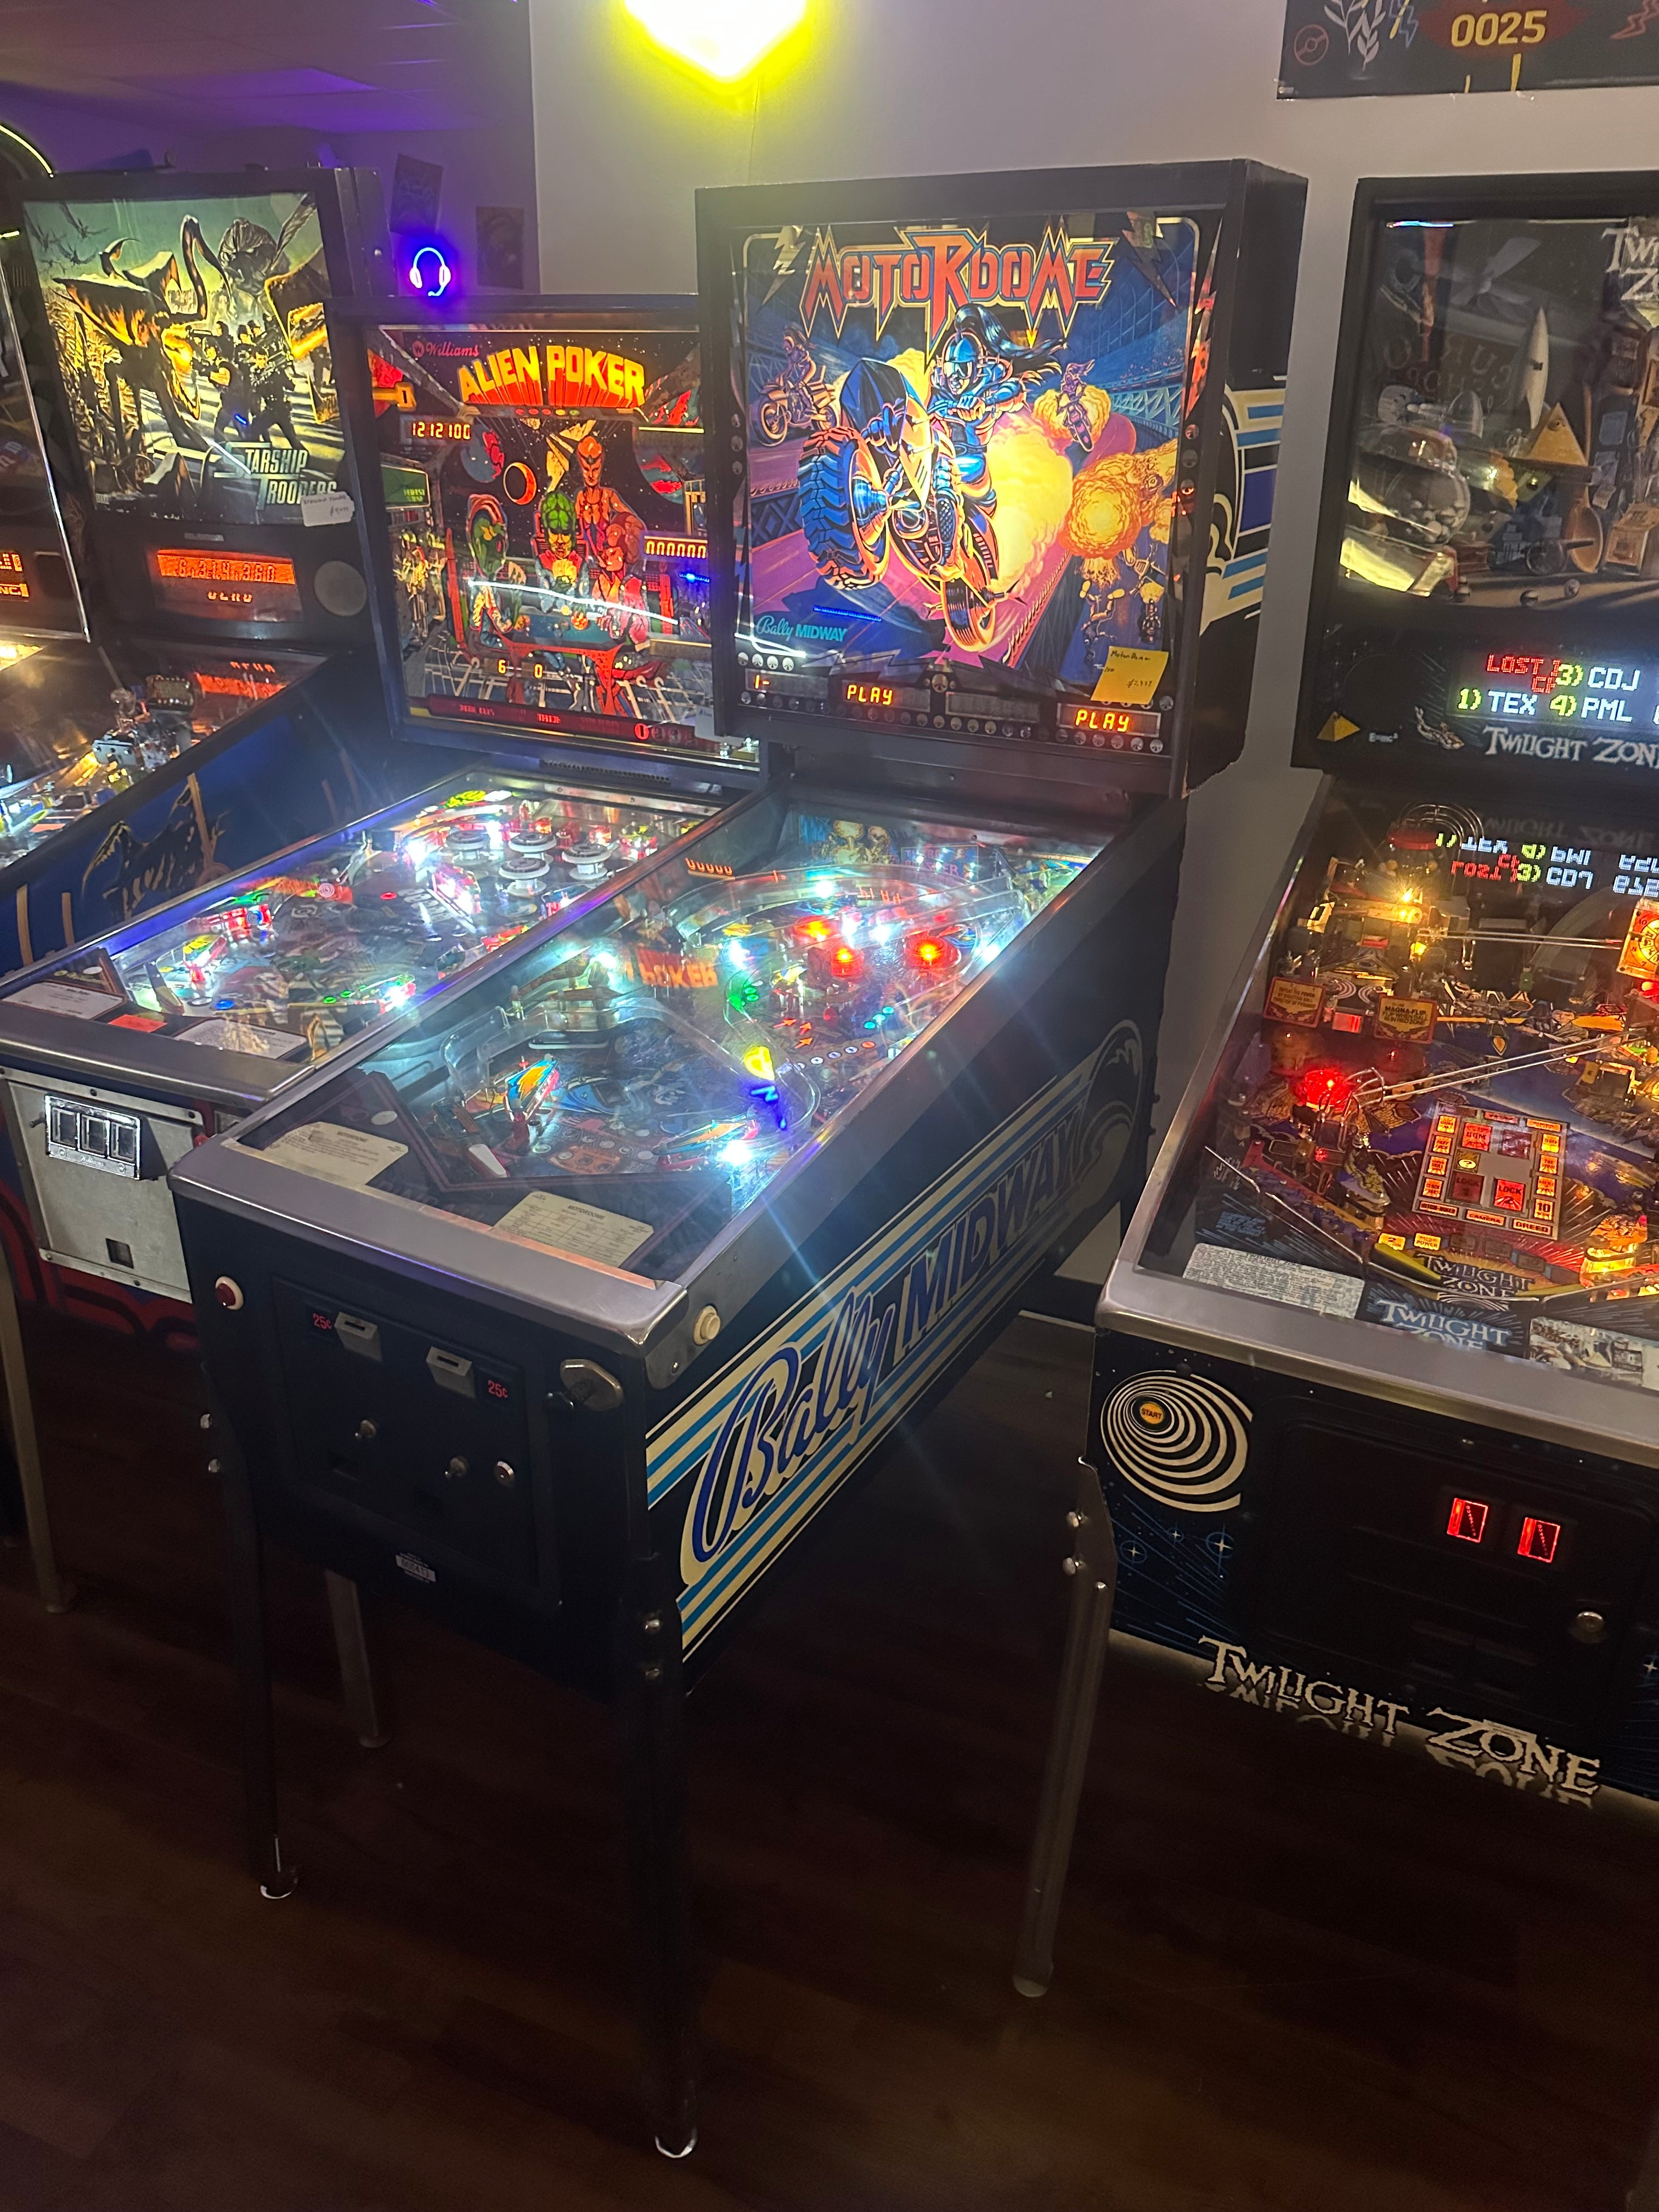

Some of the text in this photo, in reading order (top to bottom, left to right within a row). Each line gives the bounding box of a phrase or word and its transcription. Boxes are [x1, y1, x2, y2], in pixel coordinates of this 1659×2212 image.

[1451, 10, 1547, 47] 0025
[799, 225, 1120, 366] MOTORDOME
[426, 341, 481, 357] Williams
[458, 345, 646, 408] ALIEN POKER
[214, 441, 309, 478] STARSHIP
[756, 615, 848, 642] Bally MIDWAY
[498, 659, 543, 678] 6 0
[1486, 653, 1544, 675] LOST
[847, 684, 893, 706] PLAY
[1487, 690, 1538, 716] TEX
[1581, 696, 1633, 723] PML
[1075, 709, 1130, 732] PLAY
[1482, 725, 1659, 769] TWILIGHT ZON
[1385, 1006, 1426, 1015] MAGNA-FLIP
[1498, 1184, 1522, 1195] LOCK
[567, 1205, 606, 1220] MOTORDOME
[1537, 1202, 1551, 1212] 10
[1469, 1213, 1502, 1224] CAMERA
[1515, 1221, 1549, 1233] GREED
[1416, 1240, 1438, 1249] POWER
[1415, 1252, 1533, 1290] TWILIGHT
[1442, 1274, 1515, 1298] ZONE
[1377, 1299, 1511, 1346] TWILIGHT
[685, 1098, 1089, 1576] Bally MIDWAY
[488, 1379, 509, 1398] 25¢
[1141, 1408, 1162, 1420] START
[1198, 1635, 1600, 1795] TWILIGHT ZONE
